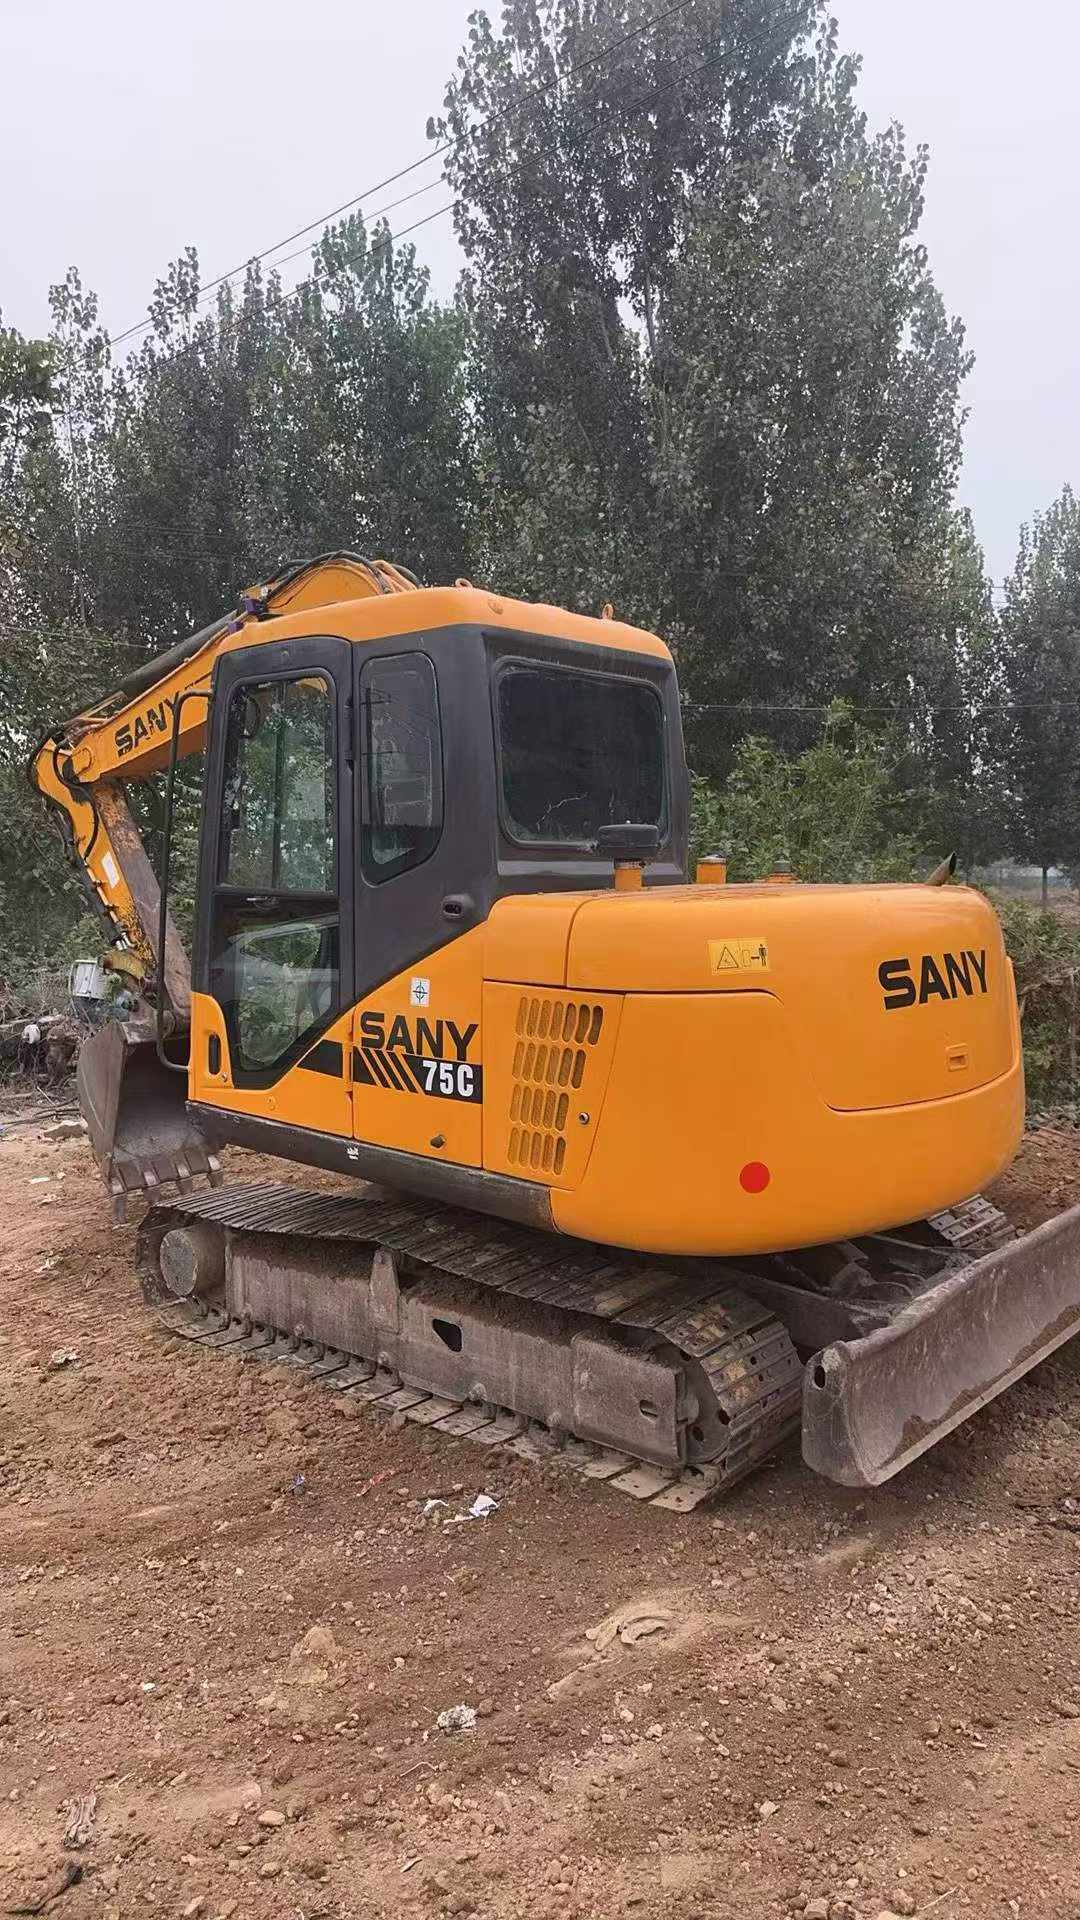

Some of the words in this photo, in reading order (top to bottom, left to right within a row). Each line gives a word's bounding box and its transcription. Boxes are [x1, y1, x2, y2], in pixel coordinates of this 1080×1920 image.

[879, 949, 988, 1010] SANY
[360, 1011, 479, 1061] SANY
[422, 1060, 474, 1097] 75C
